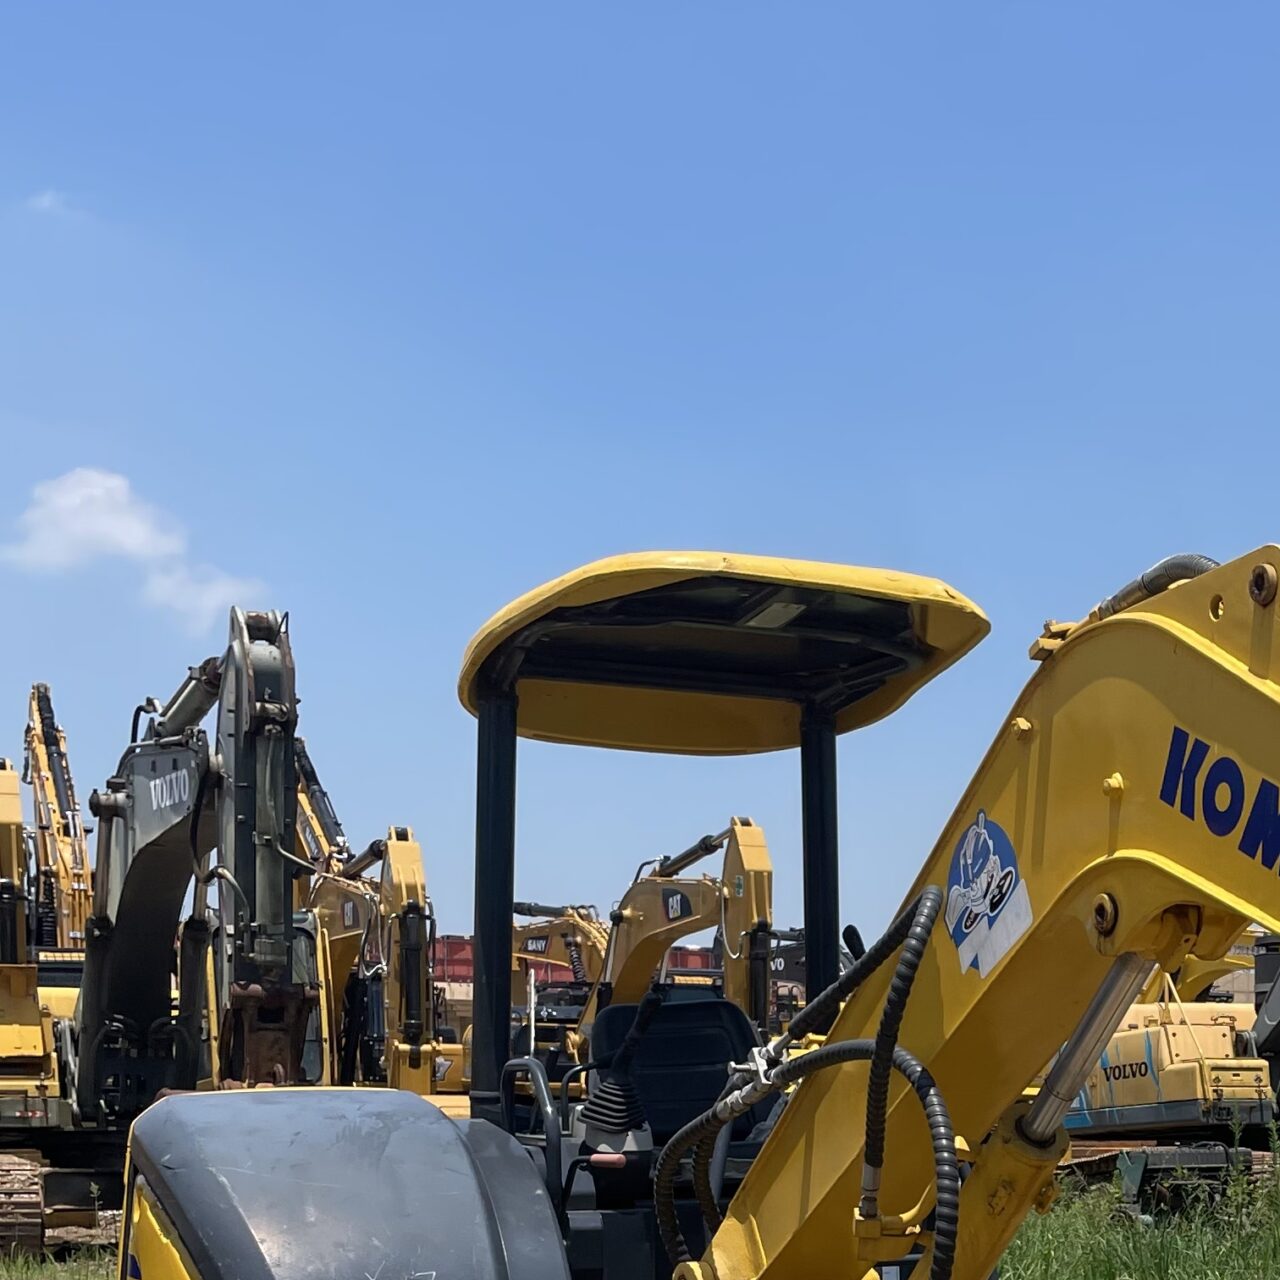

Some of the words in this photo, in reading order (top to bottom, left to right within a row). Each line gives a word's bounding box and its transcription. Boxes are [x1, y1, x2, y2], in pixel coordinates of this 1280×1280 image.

[149, 768, 189, 811] VOLVO
[668, 893, 682, 920] CAT
[1103, 1061, 1149, 1082] VOLVO
